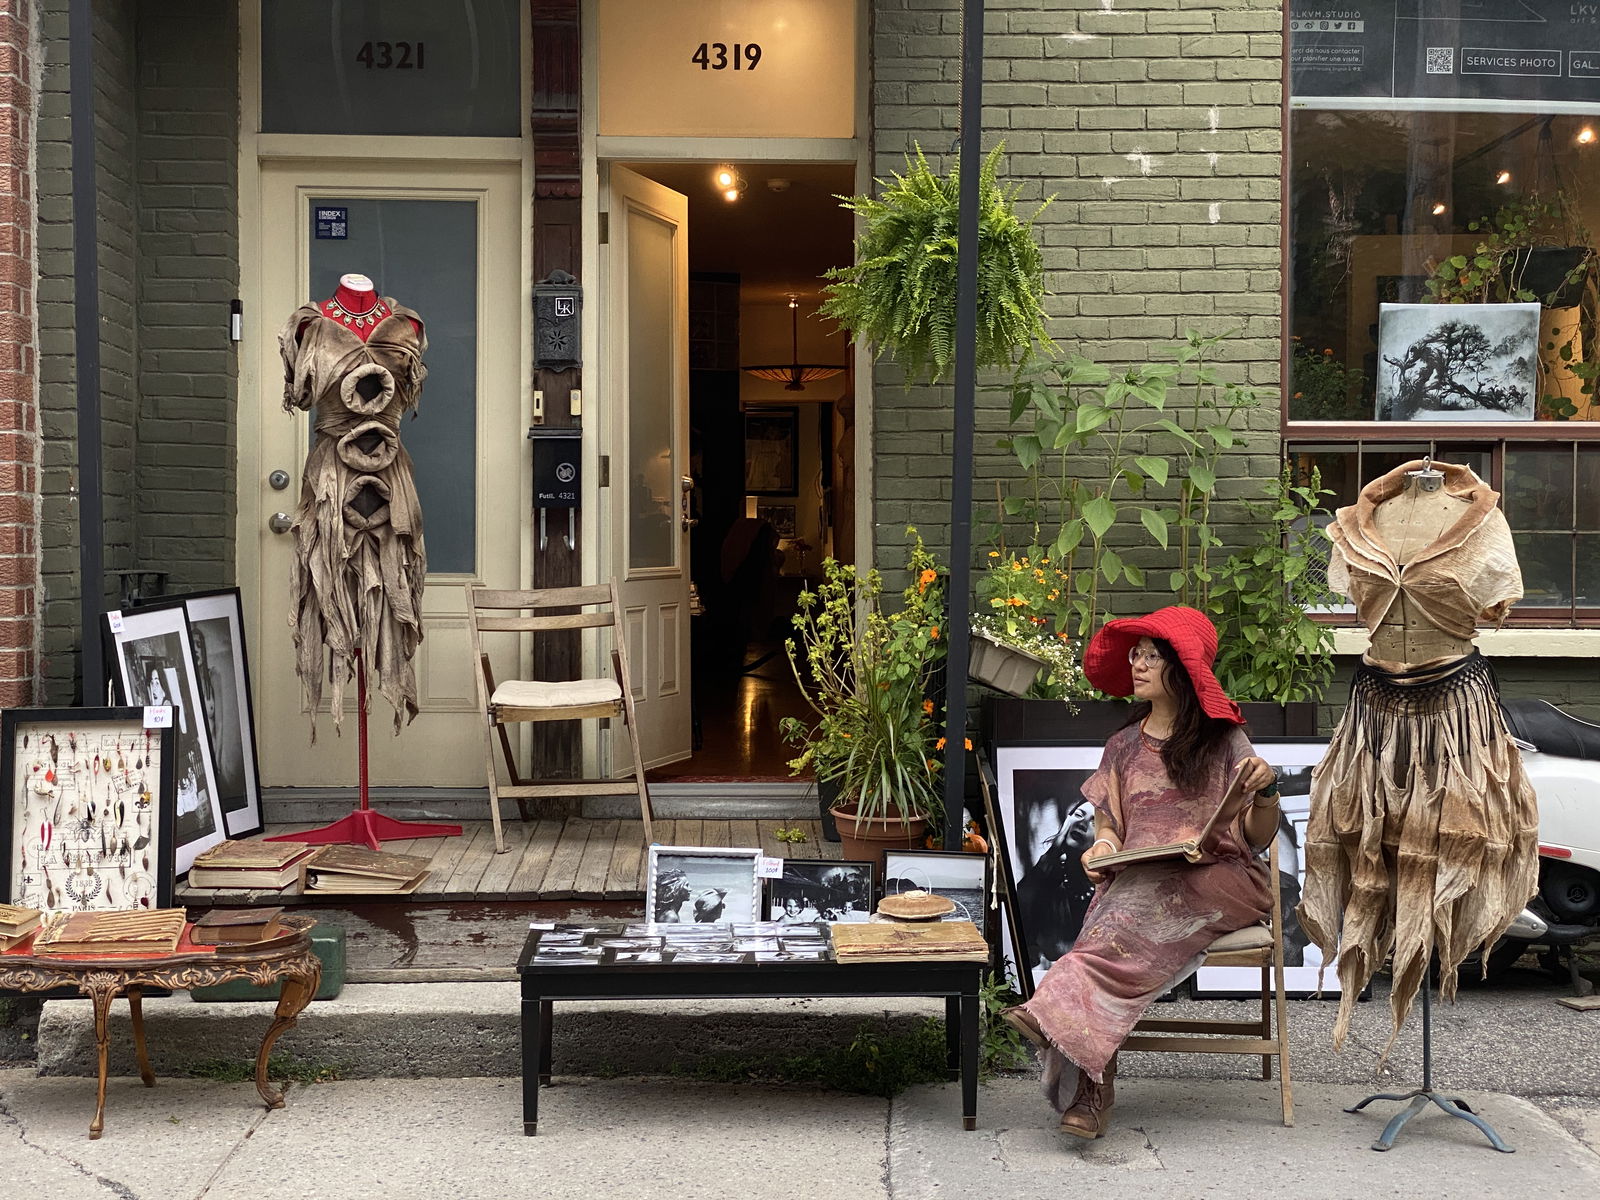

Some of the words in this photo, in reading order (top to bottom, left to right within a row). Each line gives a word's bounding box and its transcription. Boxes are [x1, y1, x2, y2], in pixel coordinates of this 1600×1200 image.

[356, 42, 424, 69] 4321
[692, 42, 762, 70] 4319
[1466, 56, 1517, 67] SERVICES
[1520, 58, 1556, 68] PHOTO
[558, 492, 575, 500] 4321
